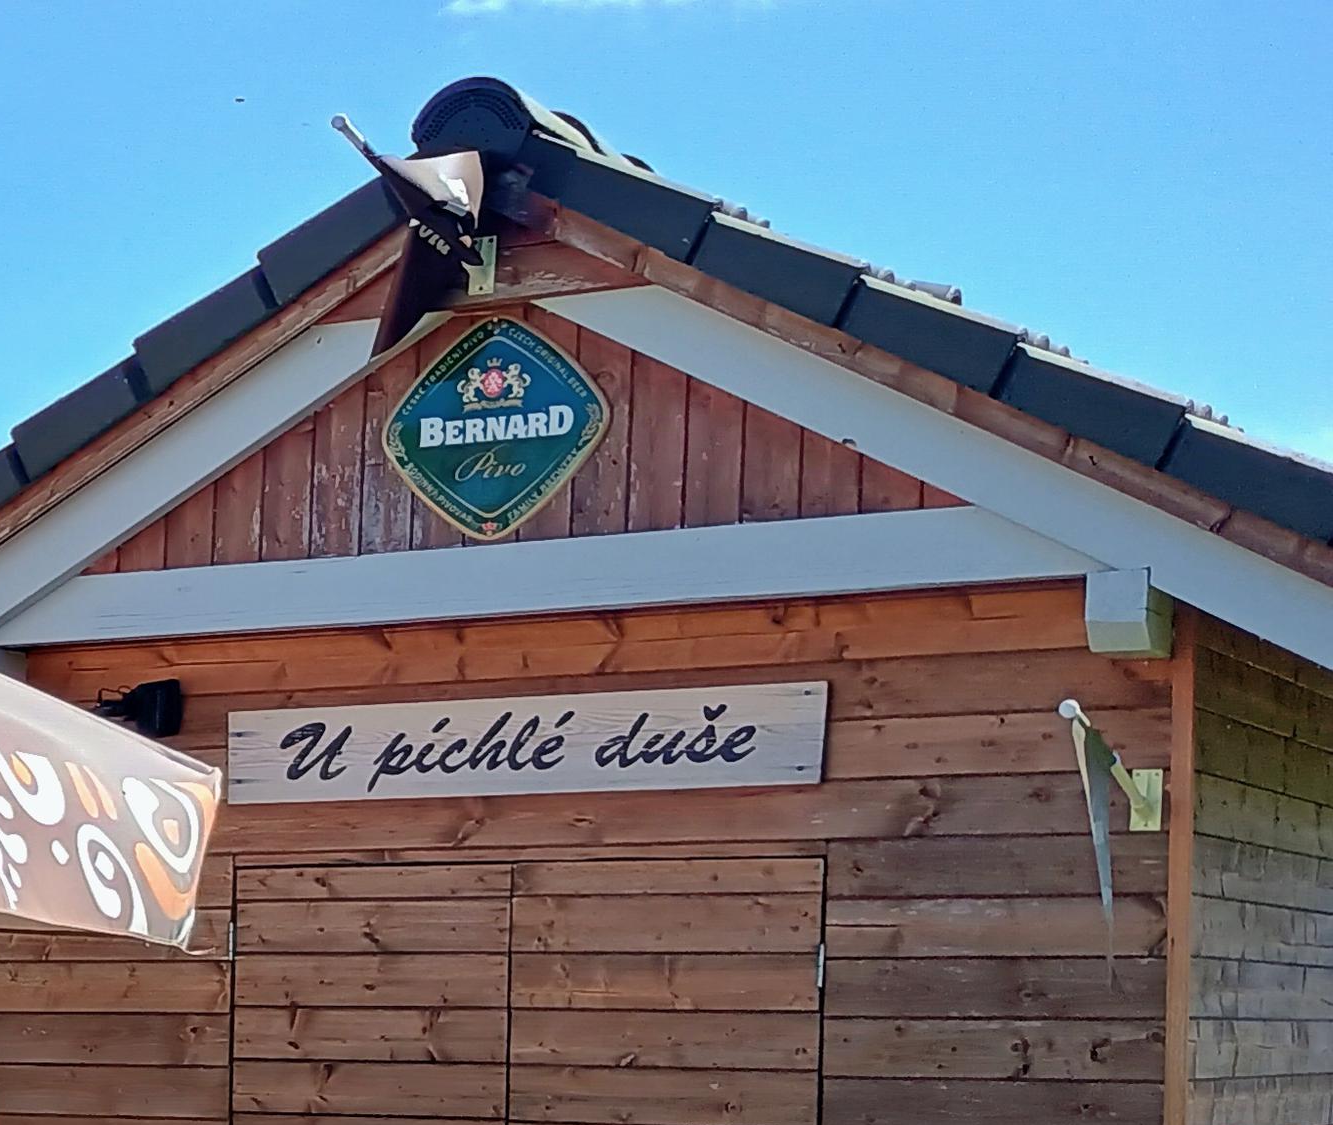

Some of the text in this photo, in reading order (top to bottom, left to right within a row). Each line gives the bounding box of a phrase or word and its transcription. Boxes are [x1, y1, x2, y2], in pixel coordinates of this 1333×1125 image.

[508, 327, 534, 348] CZECH
[419, 404, 575, 448] BERNARD
[454, 443, 527, 482] Pivo
[507, 489, 541, 525] FAMILY
[278, 721, 354, 782] U
[594, 703, 757, 770] duše
